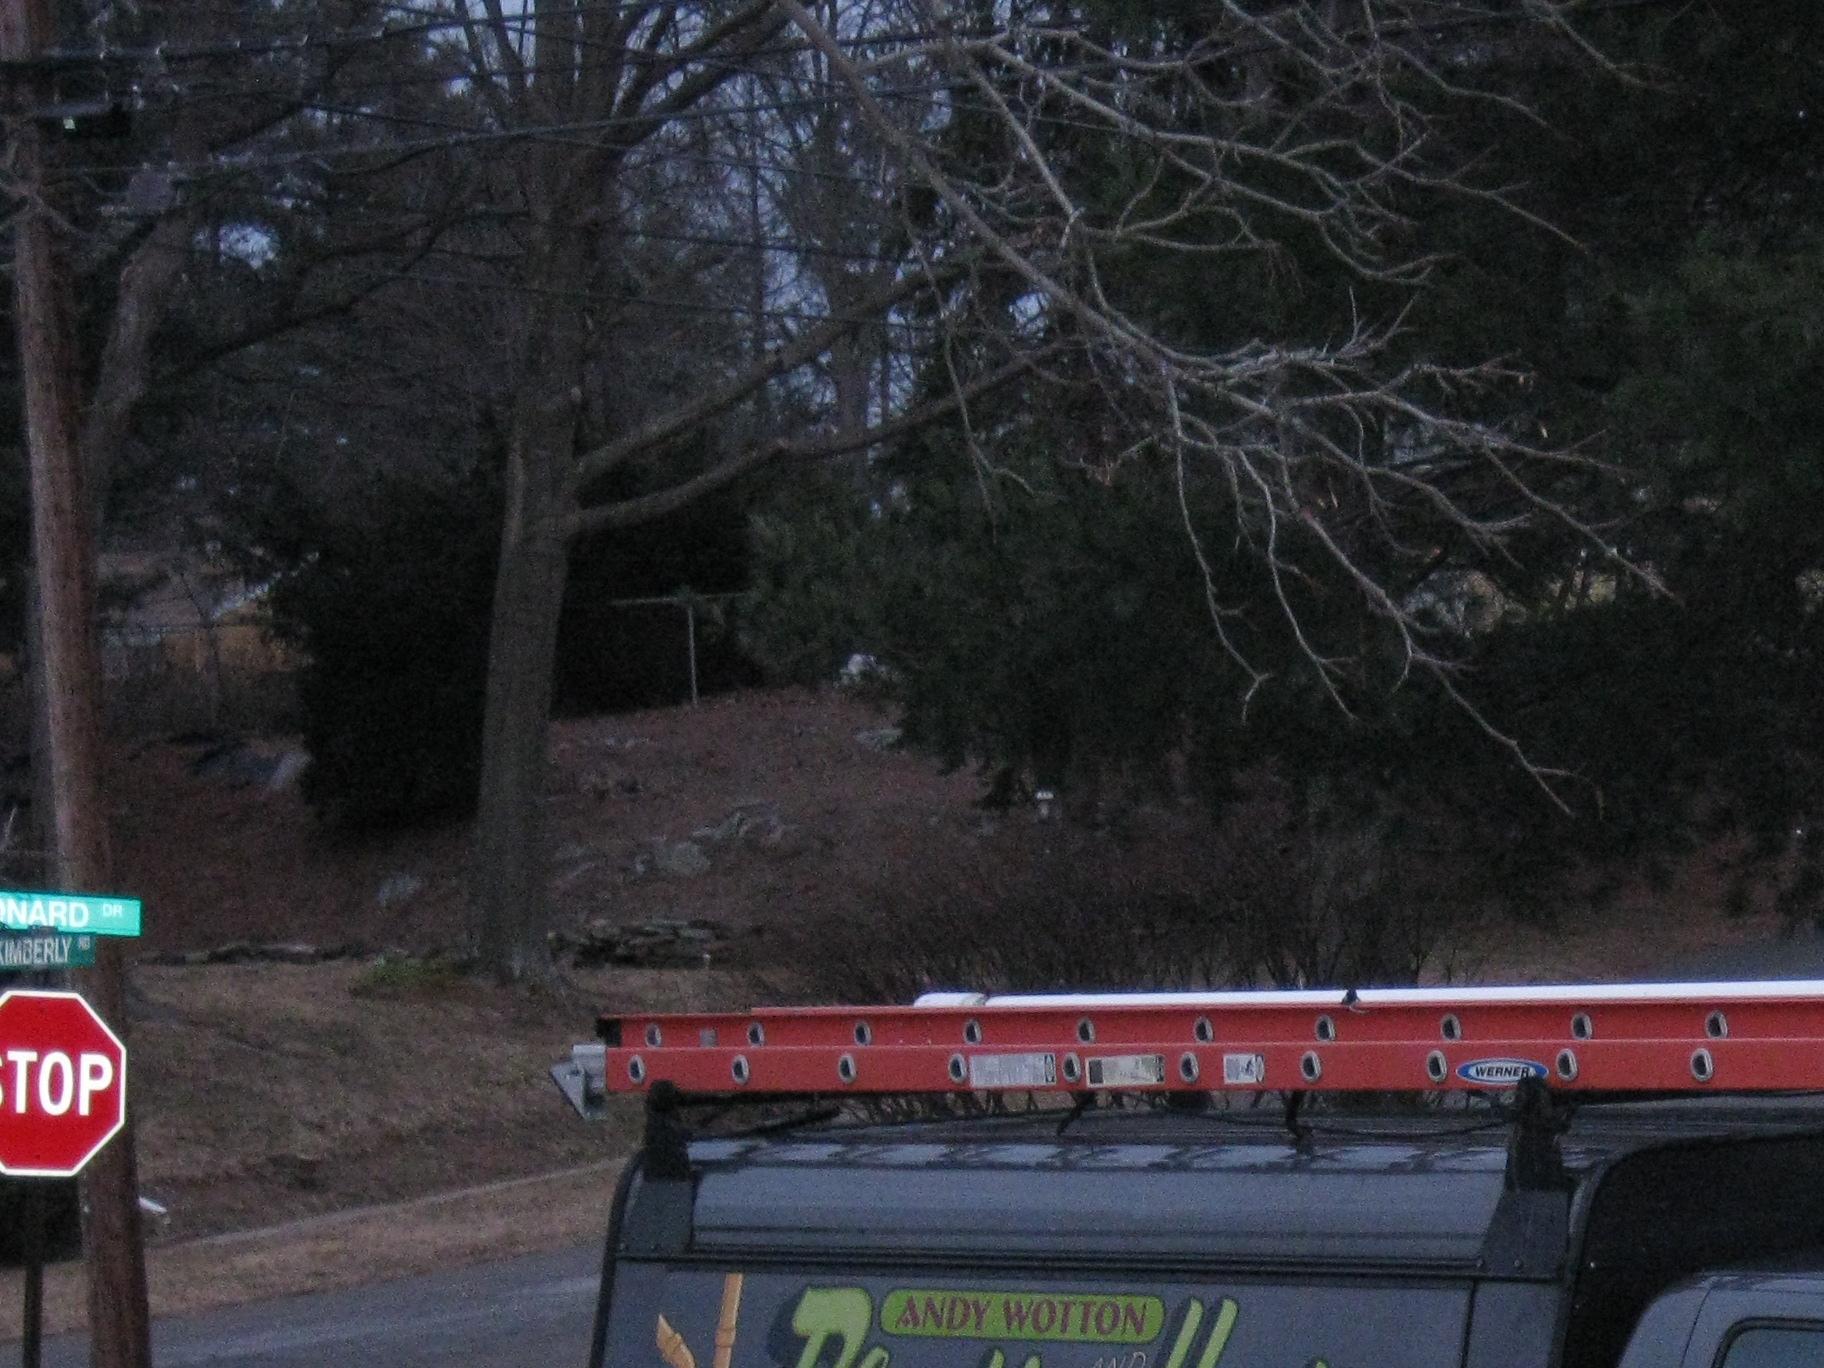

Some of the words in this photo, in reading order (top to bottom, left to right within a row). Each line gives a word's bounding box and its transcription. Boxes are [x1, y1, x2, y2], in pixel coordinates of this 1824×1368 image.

[102, 903, 123, 917] DR
[0, 1050, 113, 1116] TOP
[1475, 1064, 1531, 1078] WERNER
[895, 1296, 990, 1332] ANDY
[1003, 1299, 1148, 1336] WOTTON
